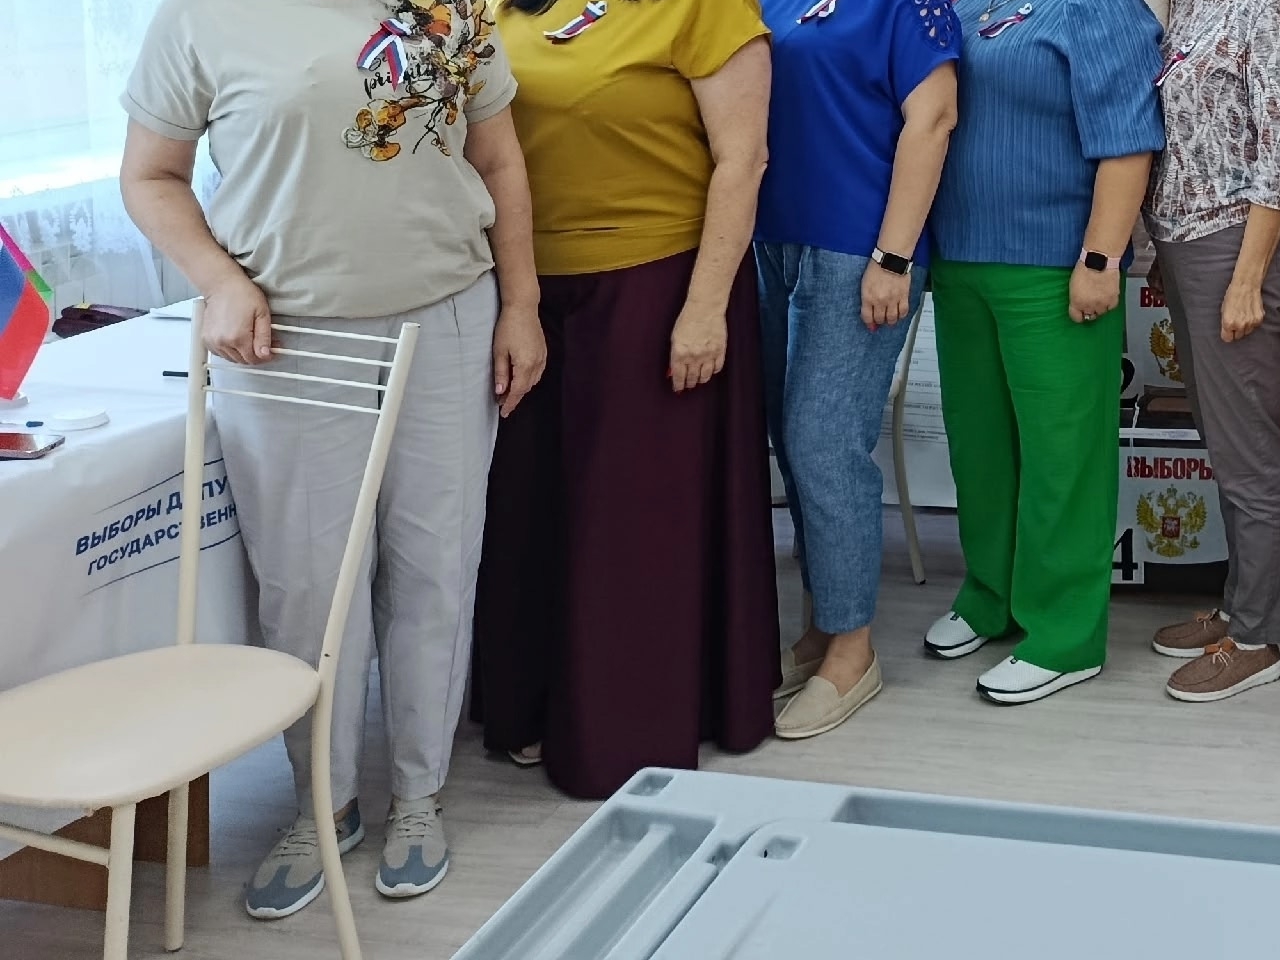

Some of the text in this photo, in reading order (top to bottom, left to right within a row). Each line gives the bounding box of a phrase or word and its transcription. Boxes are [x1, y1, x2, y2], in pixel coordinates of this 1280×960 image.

[75, 475, 228, 556] ВЫБОРЫ ДПУ
[87, 503, 237, 576] ГОСУДАРСЕНН
[1112, 528, 1138, 581] 4
